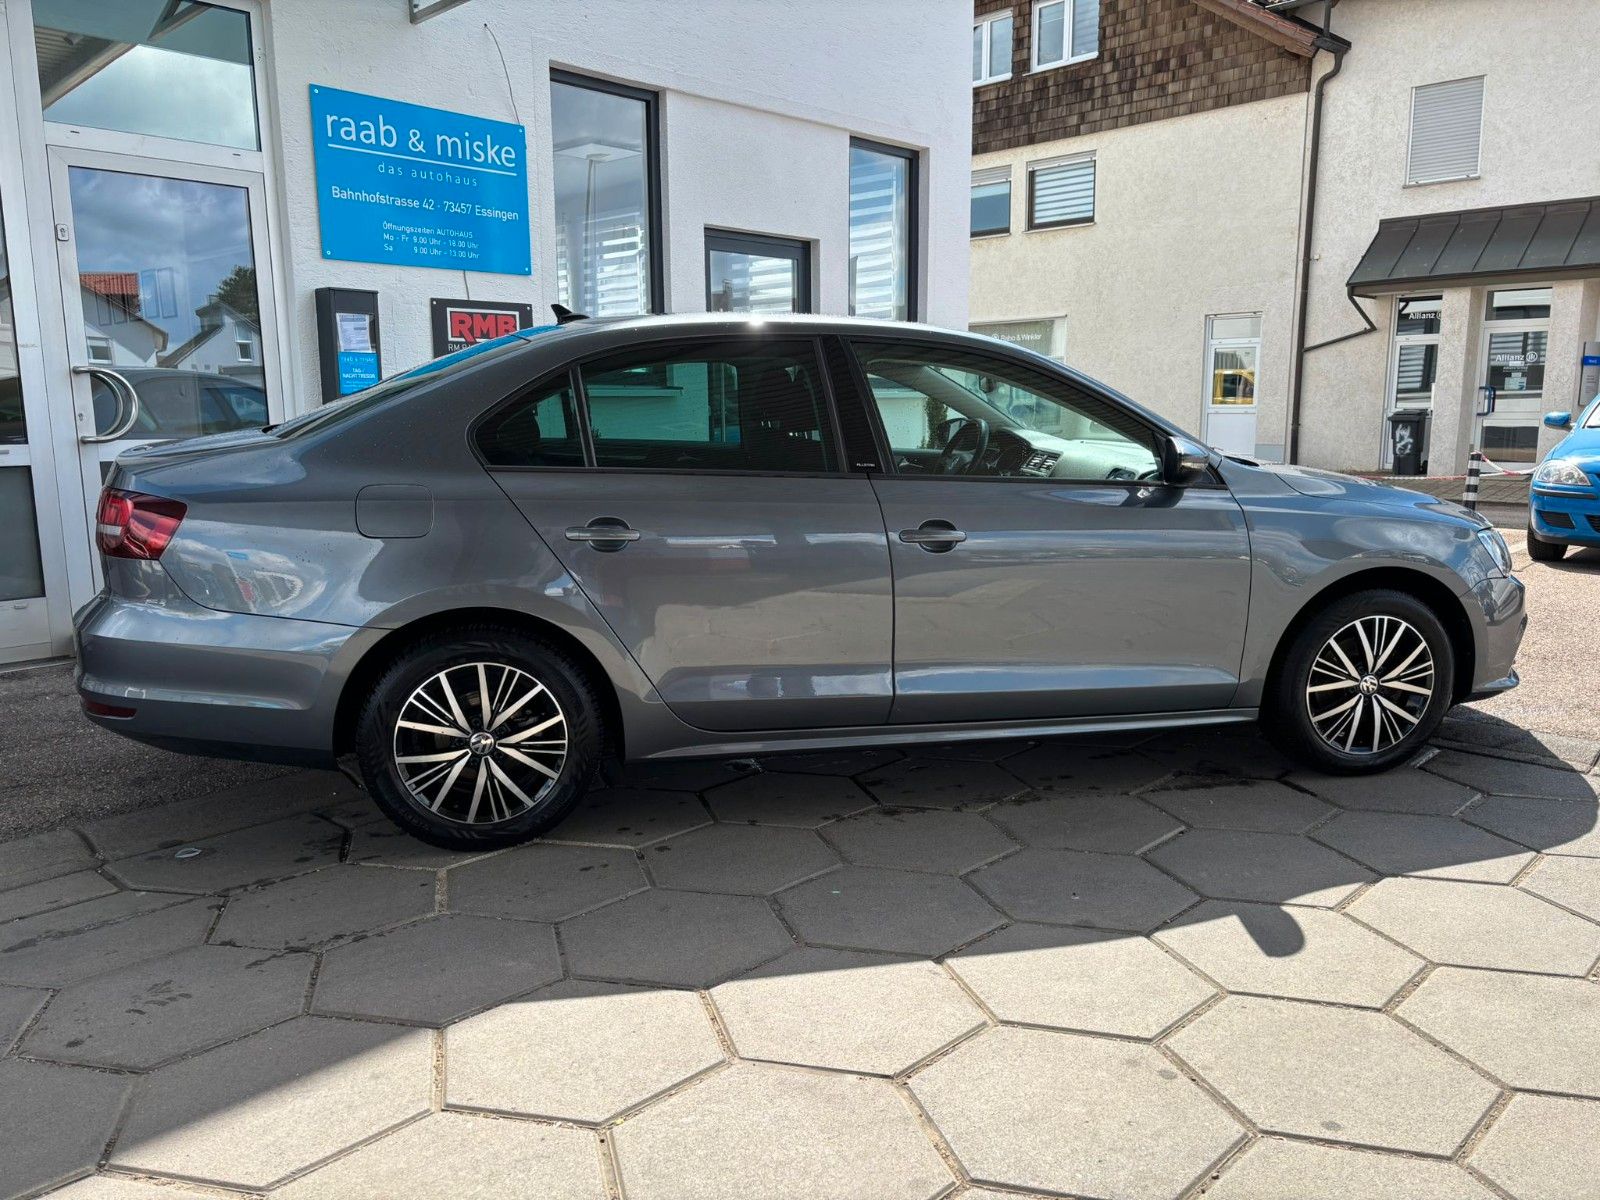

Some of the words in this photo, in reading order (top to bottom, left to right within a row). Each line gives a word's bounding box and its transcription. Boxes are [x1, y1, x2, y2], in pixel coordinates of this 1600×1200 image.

[326, 114, 397, 148] raab
[408, 129, 425, 153] &
[436, 131, 516, 168] miske
[378, 162, 403, 176] das
[411, 169, 478, 187] autohaus
[331, 186, 420, 209] Bahnhofstrasse
[422, 199, 435, 210] 42
[444, 201, 472, 215] 73457
[475, 205, 519, 222] Essingen
[383, 221, 435, 235] Öffnungszeiten
[436, 228, 473, 239] AUTOHAUS
[383, 233, 394, 241] Mo
[401, 234, 409, 242] Fr
[429, 237, 441, 246] Uhr
[467, 241, 480, 249] Uhr
[383, 243, 394, 251] Sa
[429, 247, 441, 256] Uhr
[467, 250, 480, 259] Uhr
[1409, 312, 1435, 320] Allianz
[1495, 354, 1525, 362] Allianz
